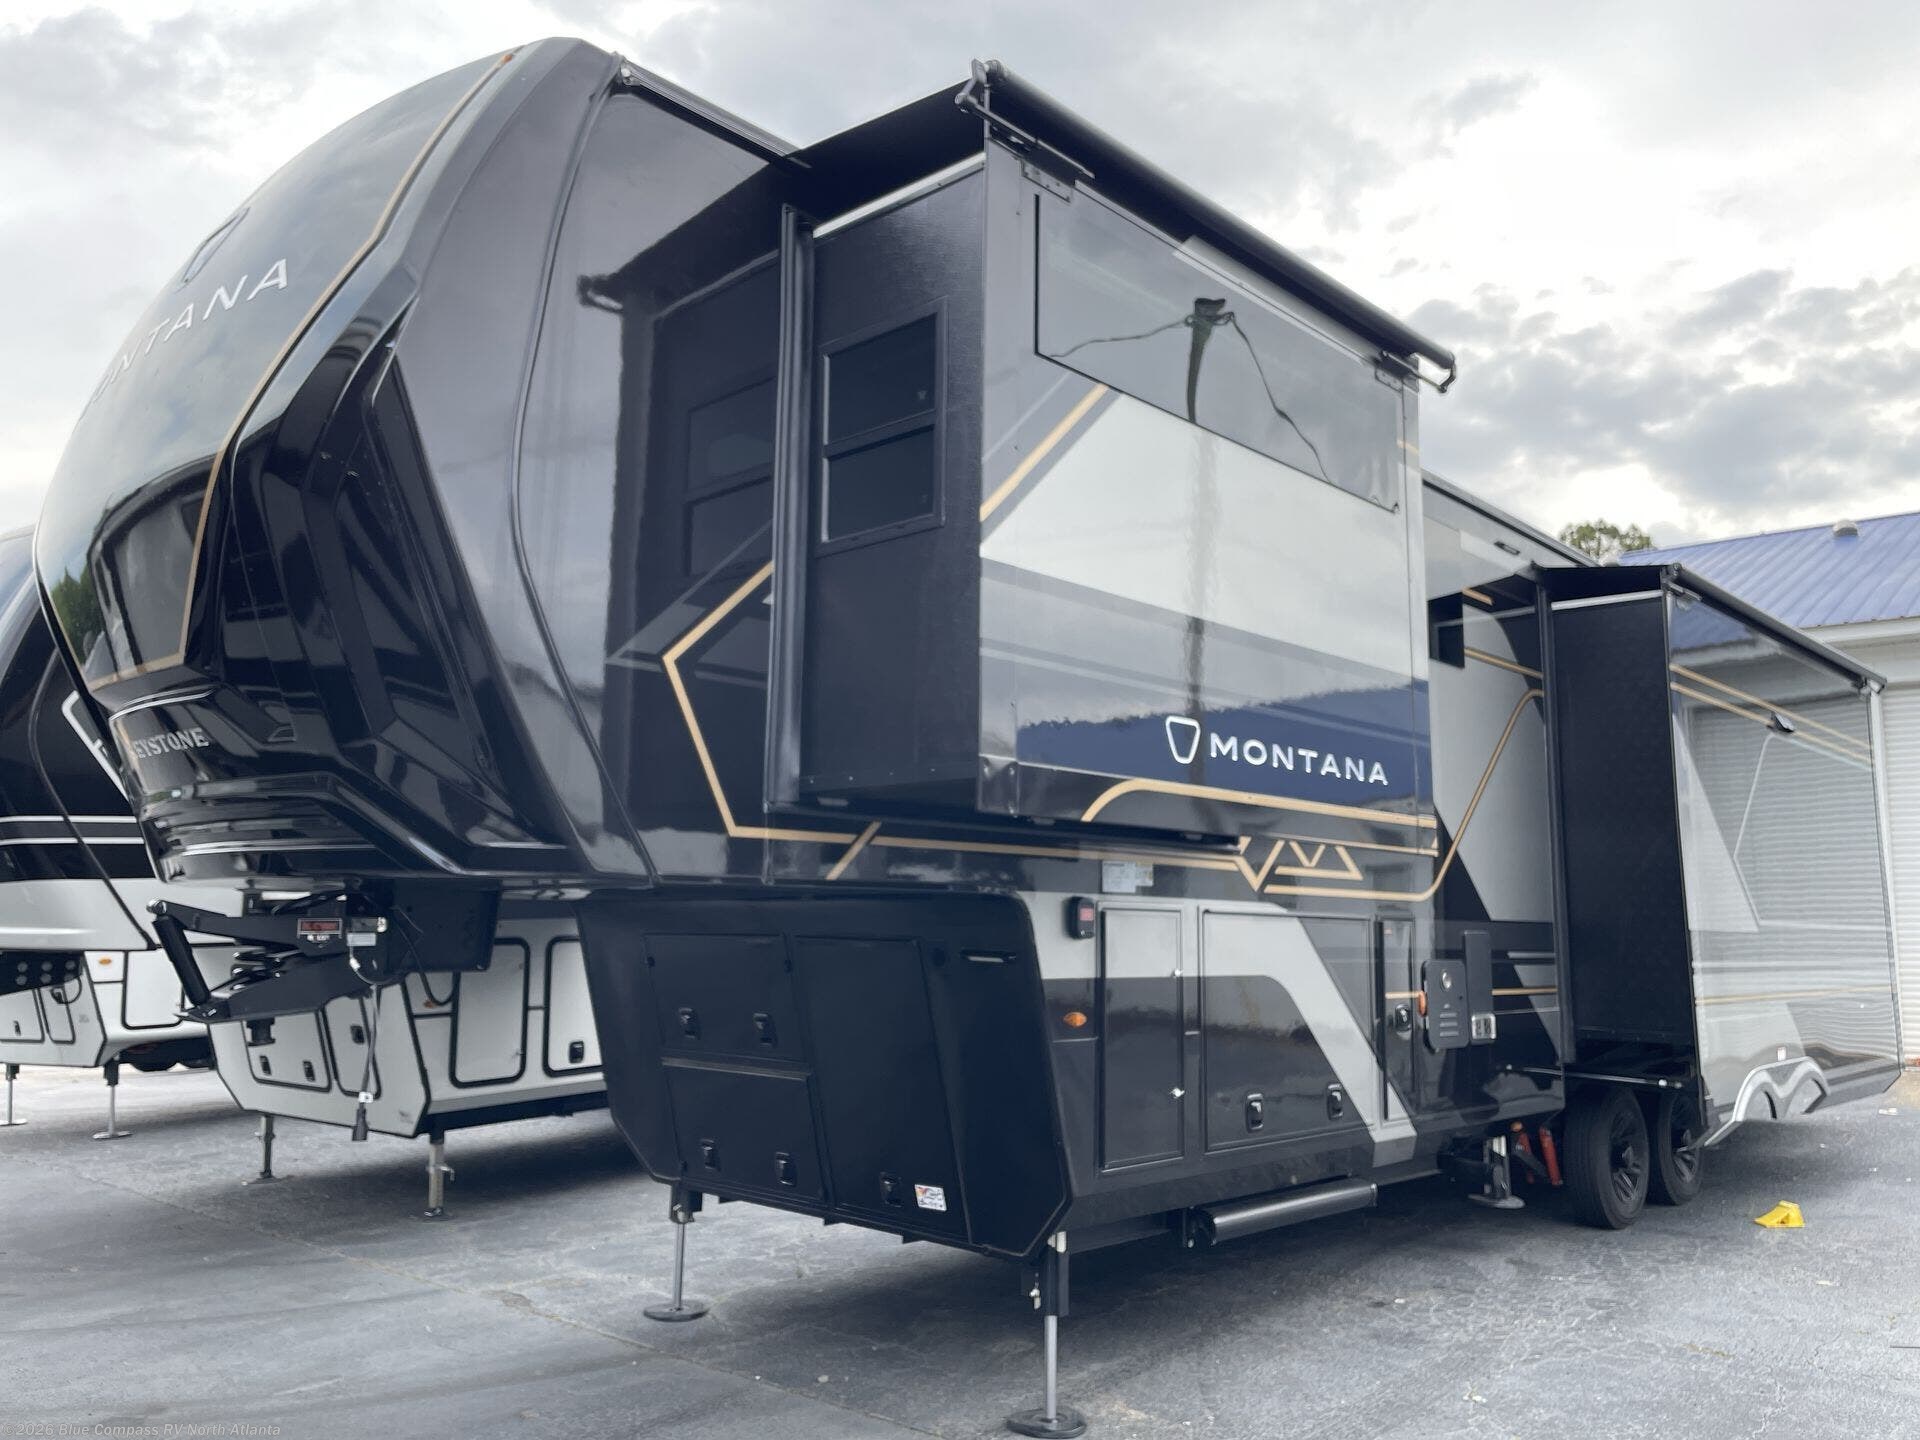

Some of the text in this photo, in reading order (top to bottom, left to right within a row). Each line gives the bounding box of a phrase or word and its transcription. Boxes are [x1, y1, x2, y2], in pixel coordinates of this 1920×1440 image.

[92, 258, 288, 404] NTANA
[132, 727, 210, 759] EYSTONE
[1210, 732, 1389, 786] MONTANA
